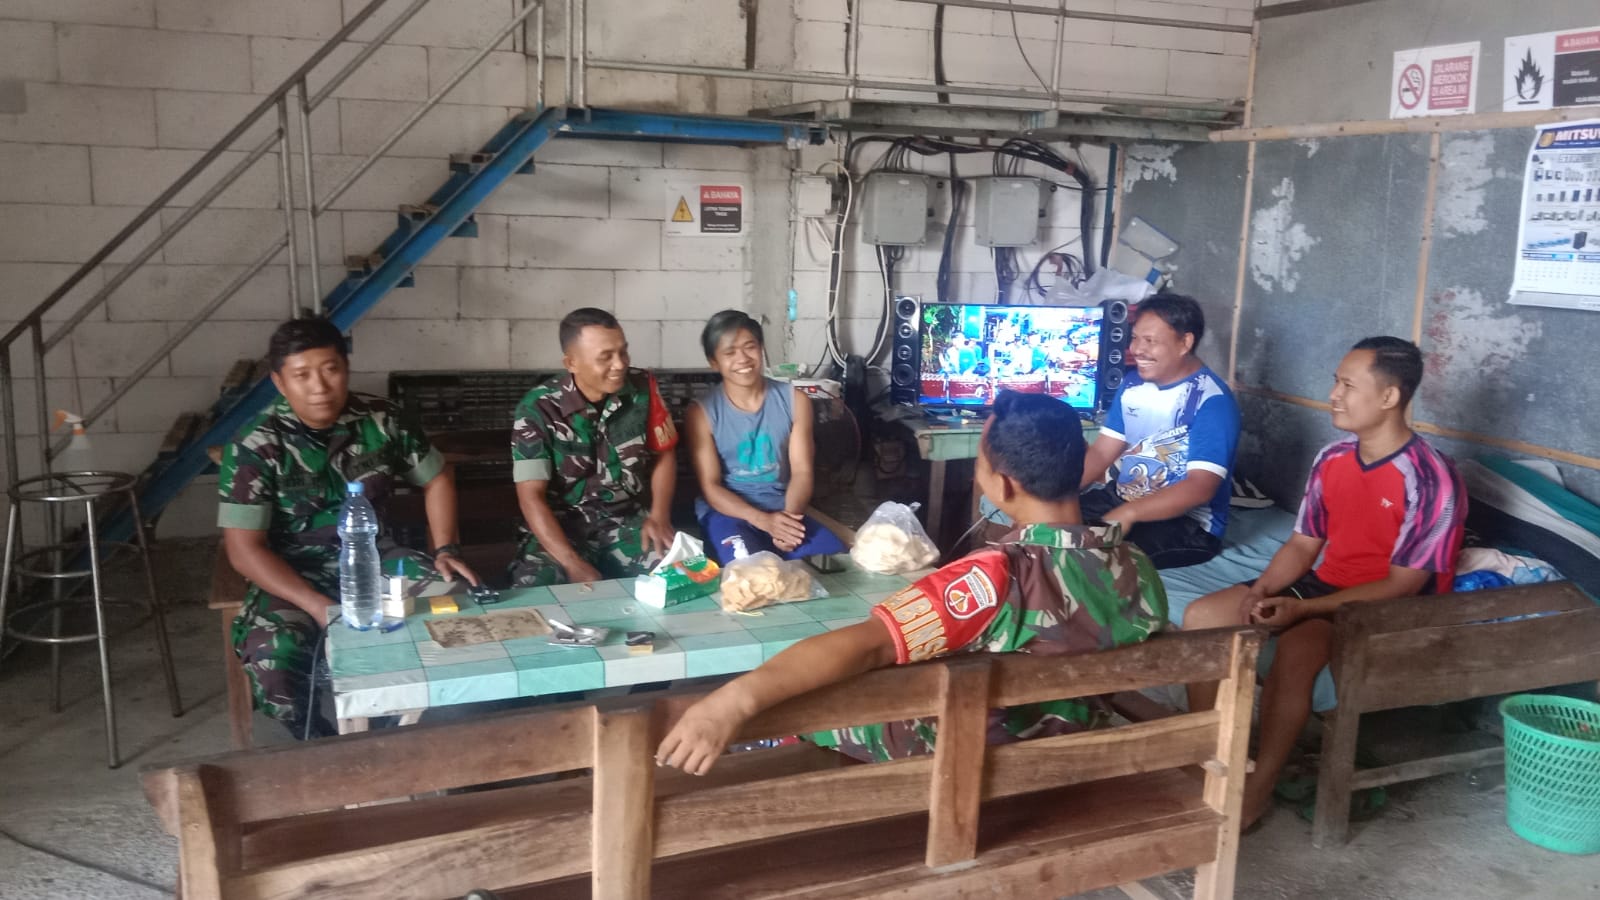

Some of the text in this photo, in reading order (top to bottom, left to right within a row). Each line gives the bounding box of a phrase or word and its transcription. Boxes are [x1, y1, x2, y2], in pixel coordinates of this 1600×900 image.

[1433, 61, 1470, 74] DILARANG
[1432, 72, 1469, 85] MEROKOK
[1431, 86, 1439, 97] DI
[1439, 84, 1457, 96] AREA
[710, 191, 739, 199] BAHAYA
[880, 584, 949, 663] ABINS
